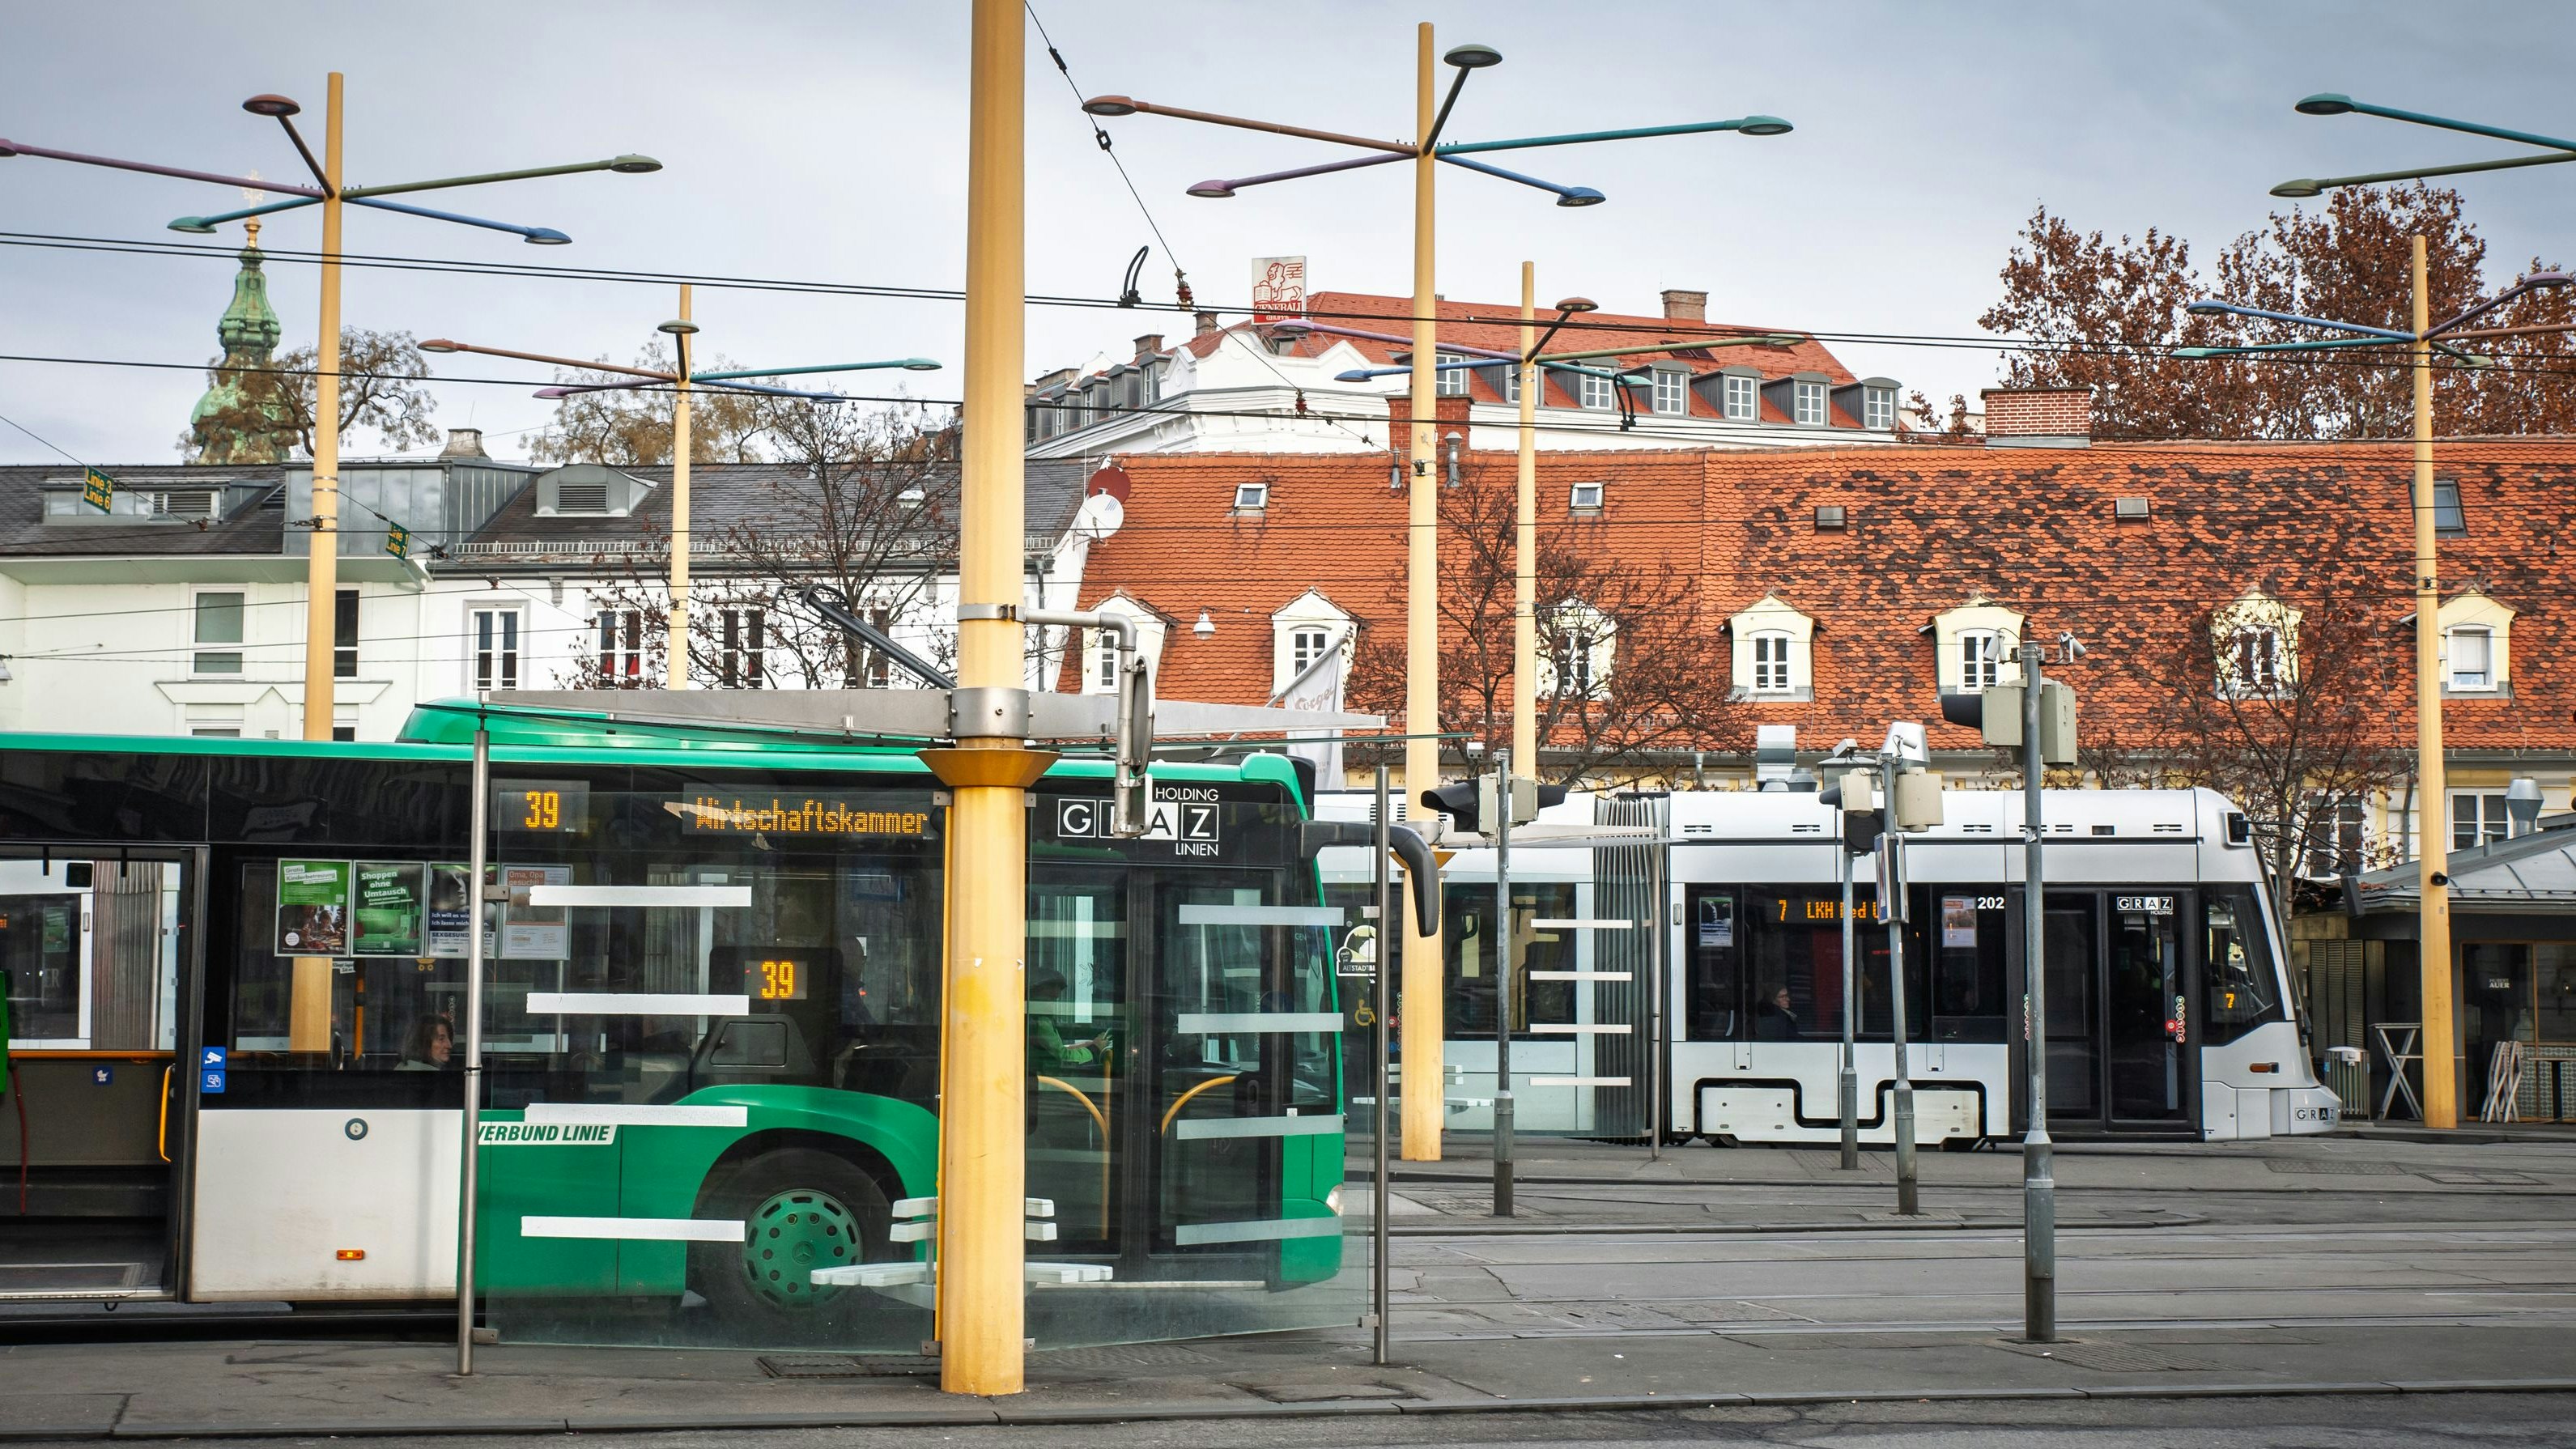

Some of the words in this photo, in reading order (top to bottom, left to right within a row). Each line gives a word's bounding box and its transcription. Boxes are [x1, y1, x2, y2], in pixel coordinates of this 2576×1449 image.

[1255, 302, 1301, 312] GENERALI
[85, 469, 105, 490] Linie
[106, 480, 112, 494] 3
[83, 485, 104, 506] Linie
[104, 495, 110, 510] 6
[402, 545, 406, 558] 7
[1155, 788, 1218, 801] HOLDING
[525, 791, 559, 828] 39
[695, 797, 928, 835] Wirtschaftskammer
[1062, 803, 1211, 838] GAZ
[1175, 843, 1218, 856] LINIEN
[361, 871, 397, 881] Shoppen
[508, 870, 528, 879] Oma,
[529, 871, 544, 880] Opa
[364, 887, 406, 898] Umtausch
[1977, 896, 2005, 909] 202
[2119, 898, 2172, 909] GRAZ
[1778, 899, 1787, 921] 7
[1806, 901, 1834, 919] LKH
[761, 961, 794, 998] 39
[2225, 993, 2235, 1009] 7
[2296, 1109, 2335, 1120] GRAZ
[562, 1125, 610, 1141] LINIE
